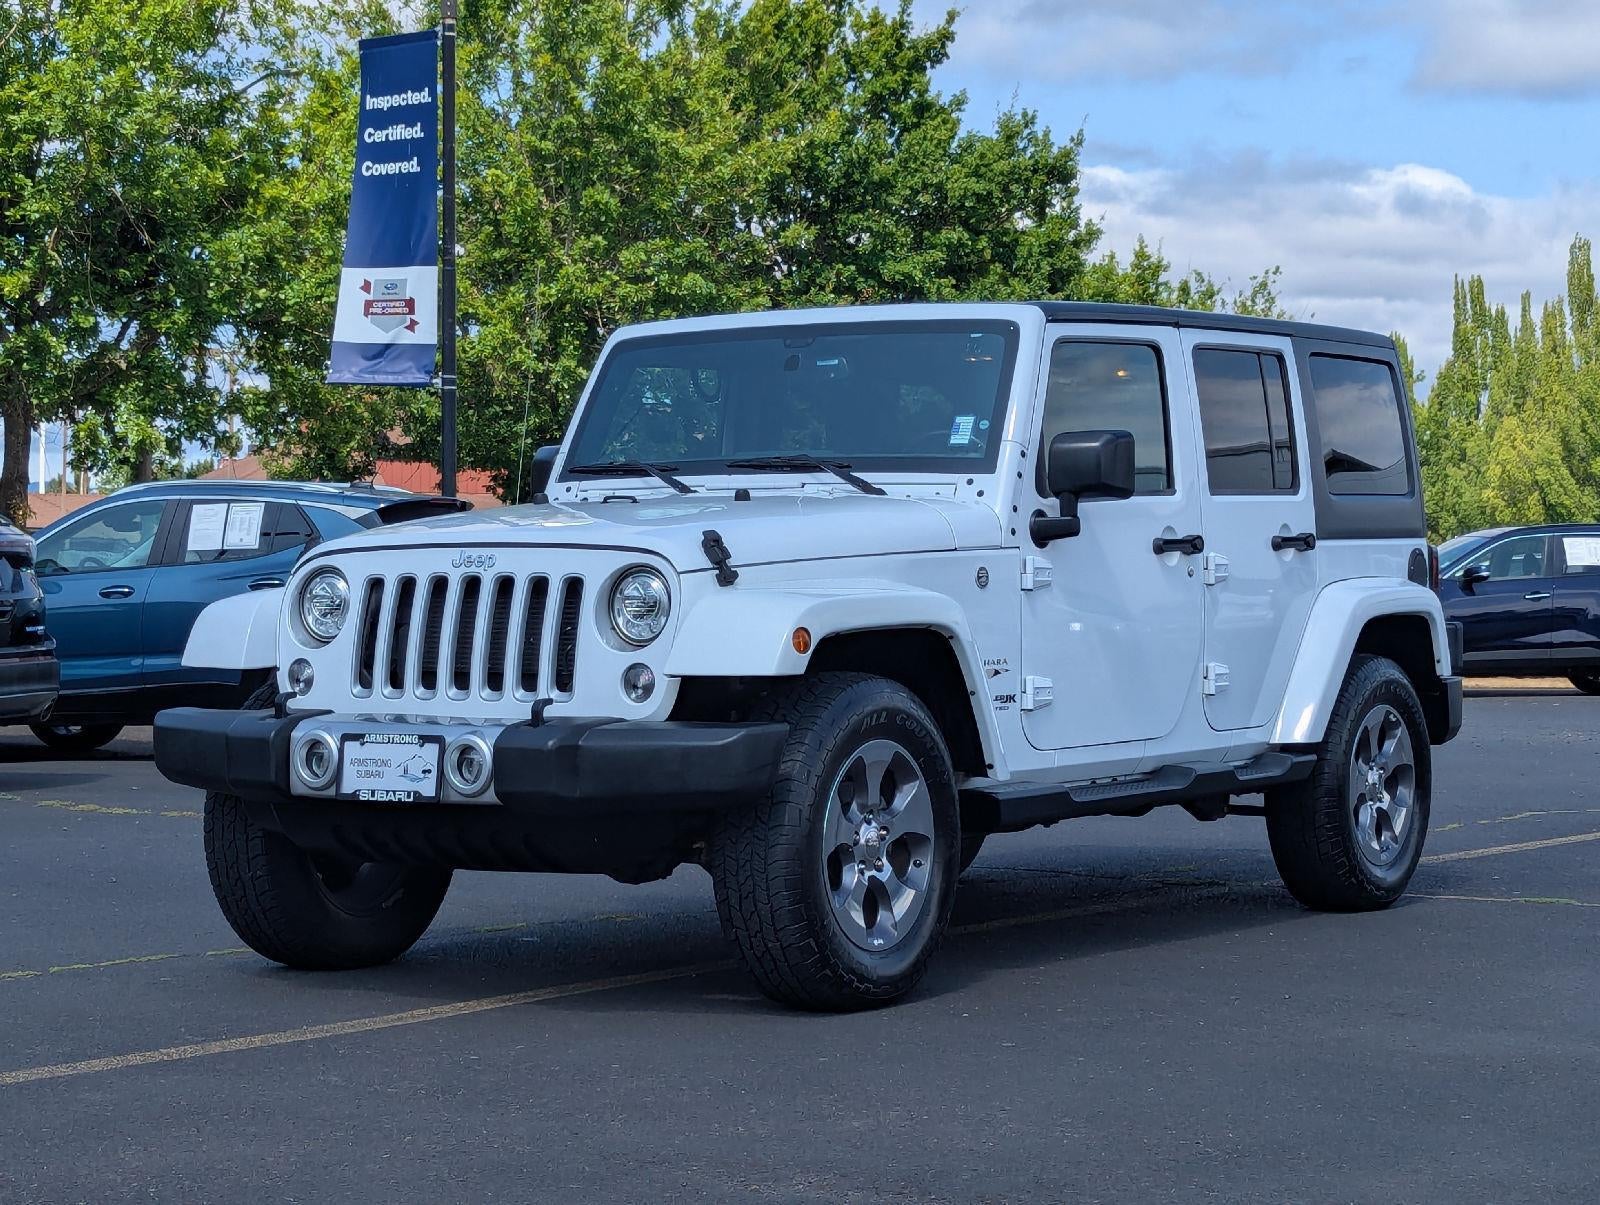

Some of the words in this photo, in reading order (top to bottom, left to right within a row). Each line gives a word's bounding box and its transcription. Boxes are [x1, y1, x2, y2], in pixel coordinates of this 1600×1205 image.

[366, 87, 432, 111] Inspected.
[364, 122, 424, 143] Certified.
[361, 156, 421, 176] Covered.
[452, 549, 497, 571] Jeep
[364, 734, 418, 744] ARMSTRONG
[349, 758, 392, 768] ARMSTRONG
[355, 770, 384, 779] SUBARU
[359, 790, 414, 802] SUBARU
